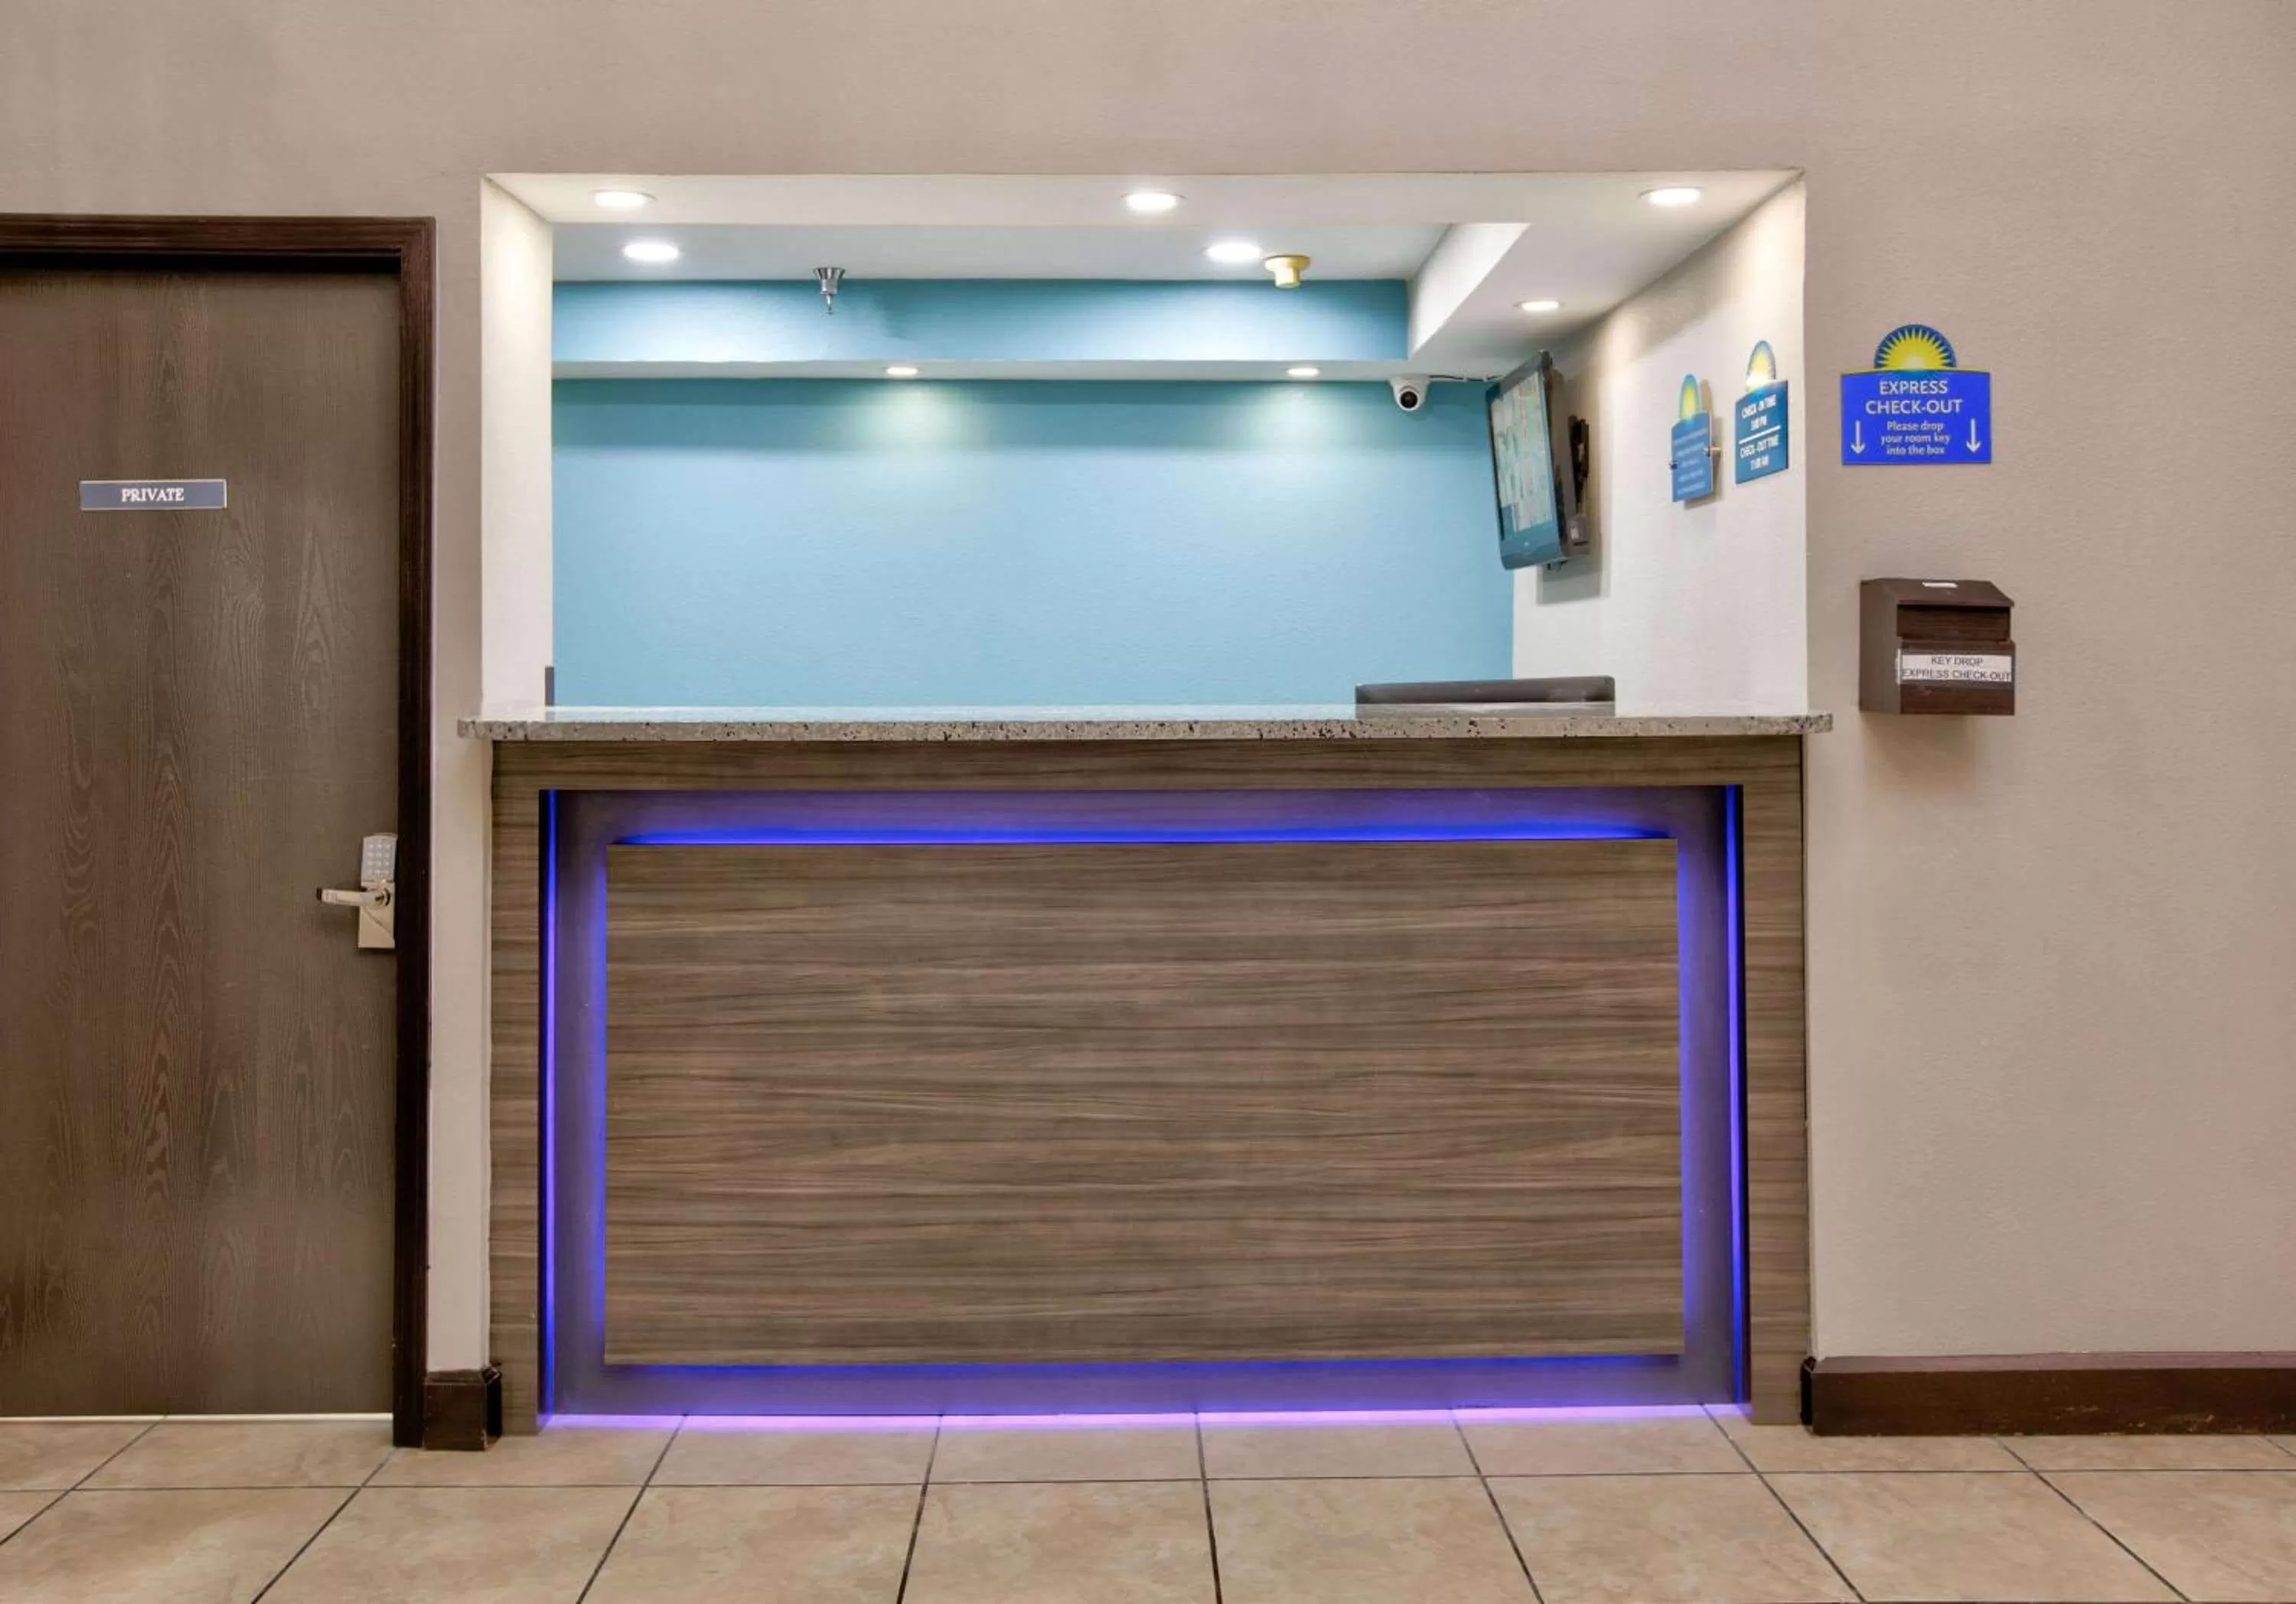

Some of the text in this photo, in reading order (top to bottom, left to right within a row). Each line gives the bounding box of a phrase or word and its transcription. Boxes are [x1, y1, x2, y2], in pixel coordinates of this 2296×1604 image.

[1880, 380, 1948, 395] EXPRESS
[1865, 399, 1963, 414] CHECK-OUT
[1887, 420, 1944, 432] Please drop
[1881, 435, 1903, 445] your
[1934, 432, 1951, 444] key
[1887, 445, 1945, 455] into the box
[121, 488, 184, 502] PRIVATE
[1931, 657, 1984, 666] KEY DROP
[1903, 669, 1949, 679] EXPRESS
